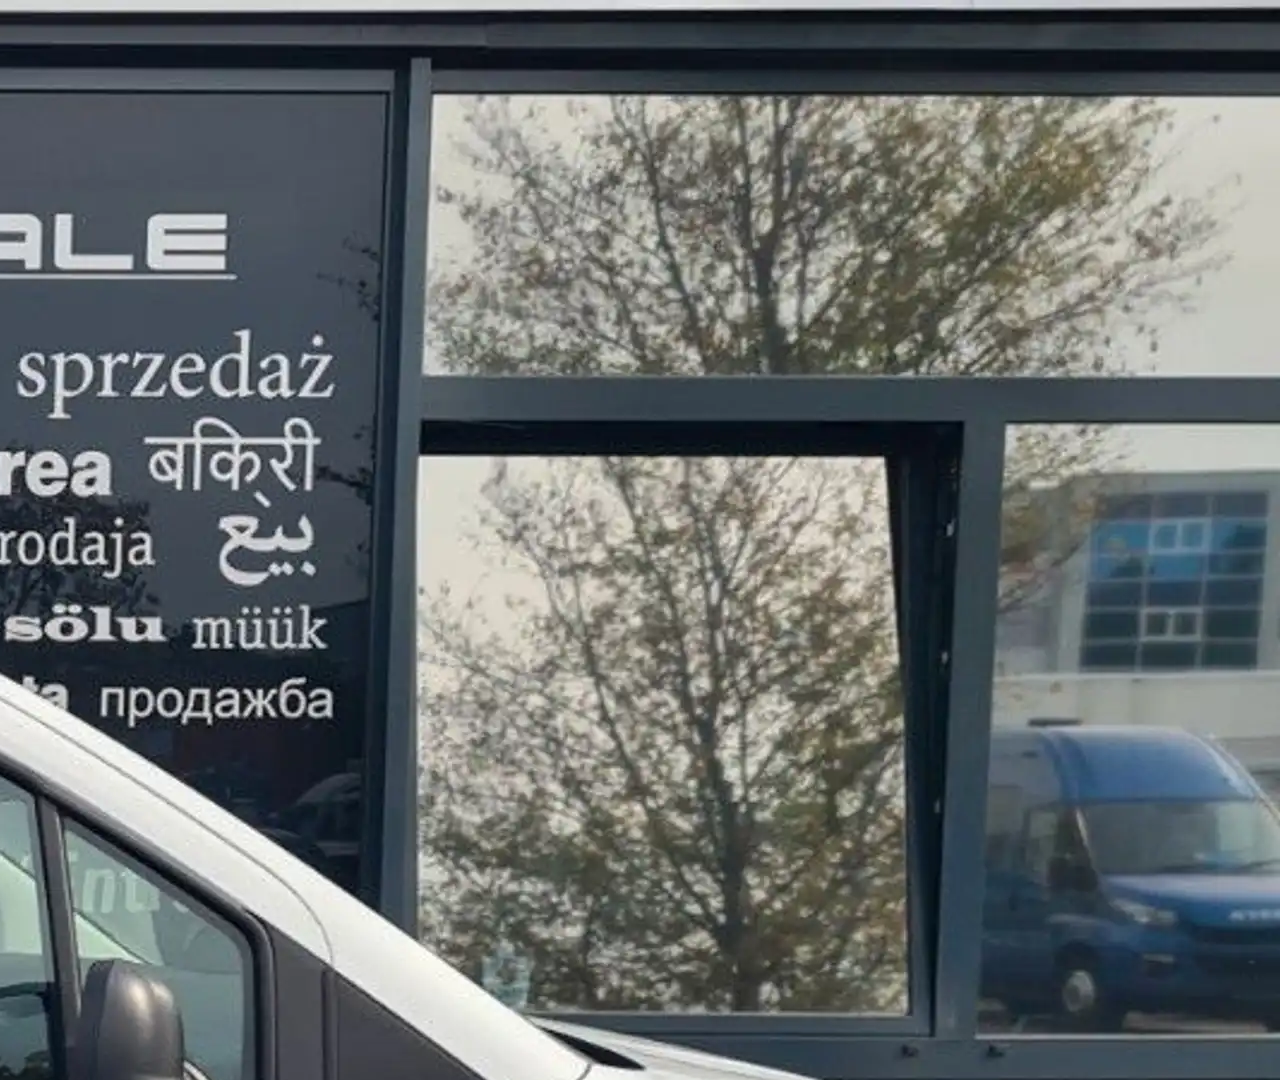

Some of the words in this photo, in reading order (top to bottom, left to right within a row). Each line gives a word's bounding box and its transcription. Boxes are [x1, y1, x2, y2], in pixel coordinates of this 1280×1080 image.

[17, 329, 335, 419] sprzedaż
[4, 603, 167, 642] sölu
[191, 604, 327, 650] müük
[100, 677, 334, 727] продажба
